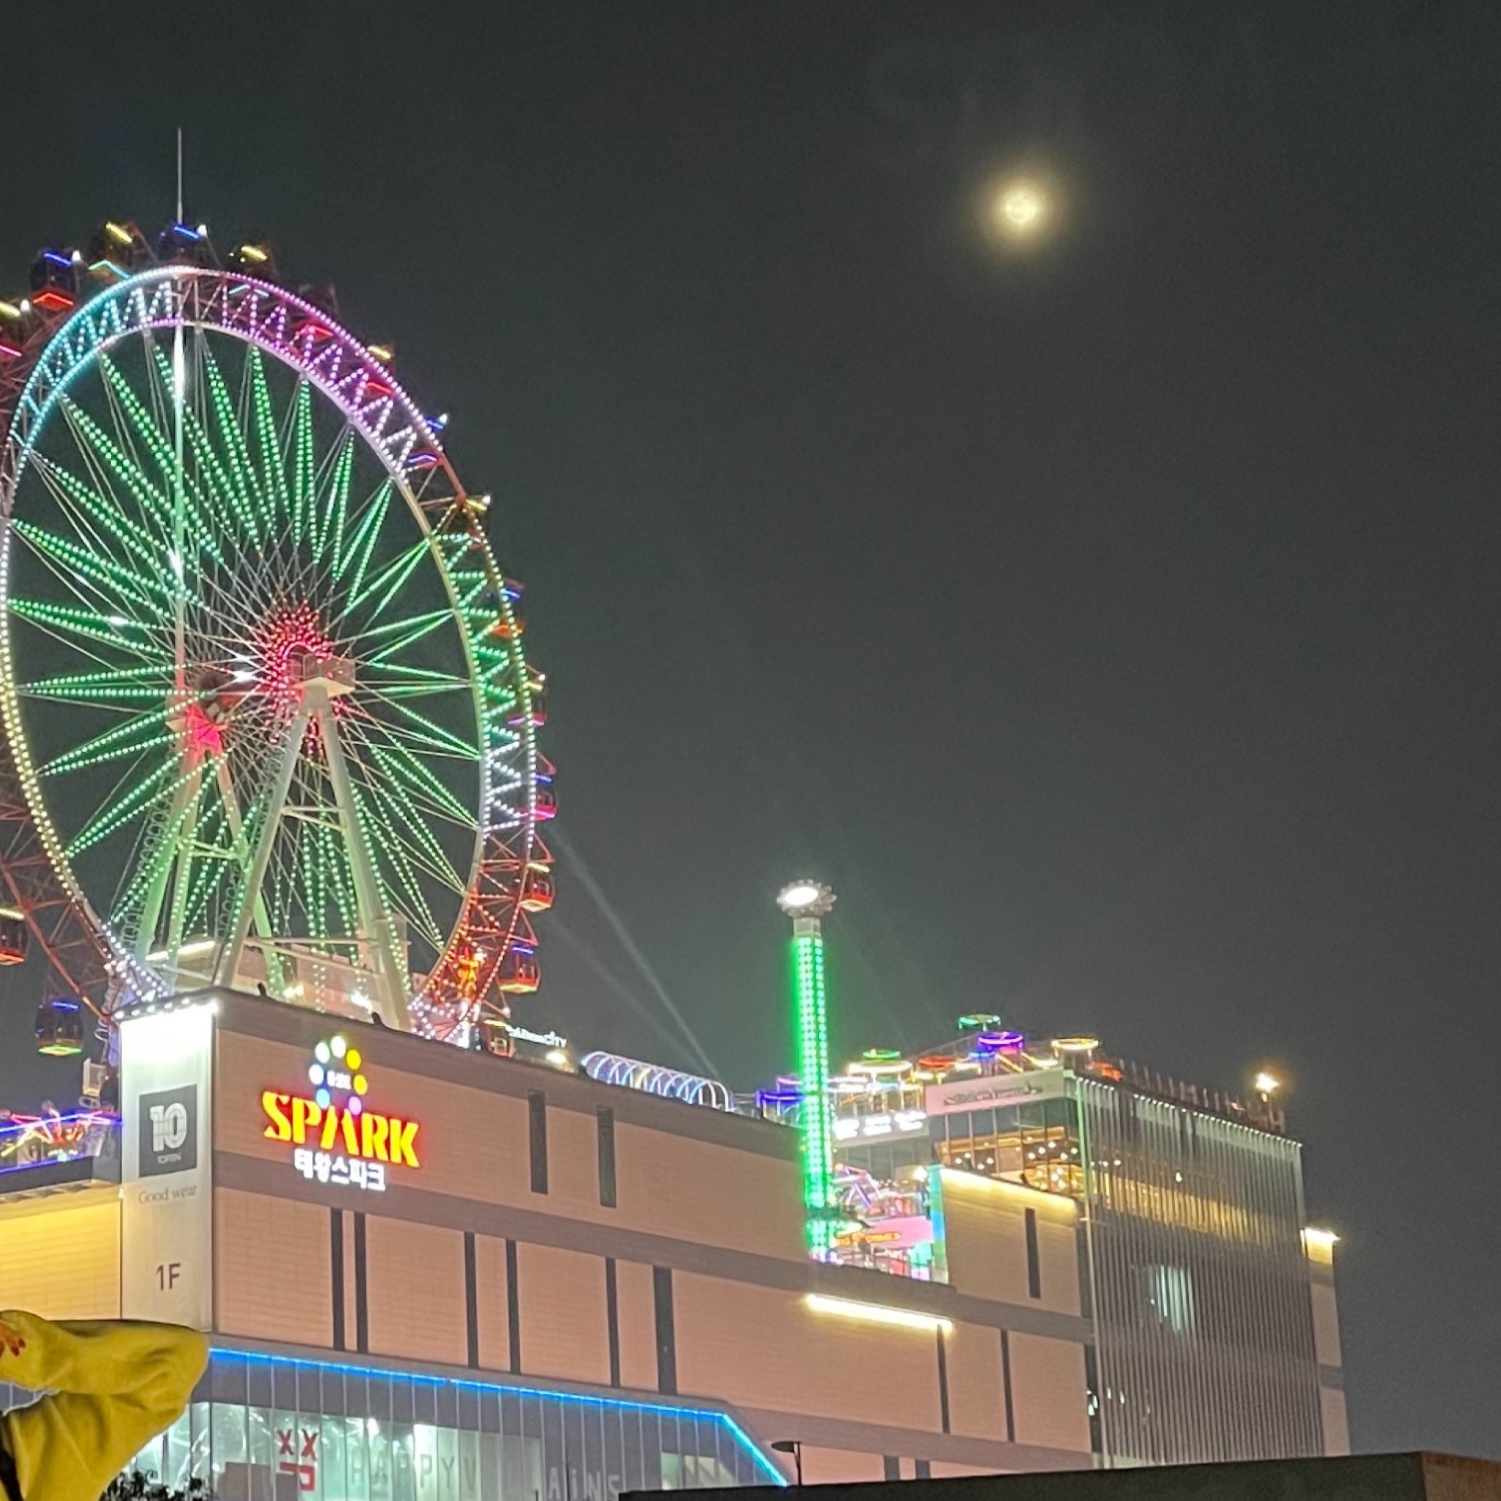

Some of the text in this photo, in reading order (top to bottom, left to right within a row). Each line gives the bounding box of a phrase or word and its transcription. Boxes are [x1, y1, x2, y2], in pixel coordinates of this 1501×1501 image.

[150, 1102, 187, 1152] 10
[262, 1090, 419, 1168] SPARK
[139, 1185, 197, 1204] Good wear
[156, 1263, 181, 1291] 1F
